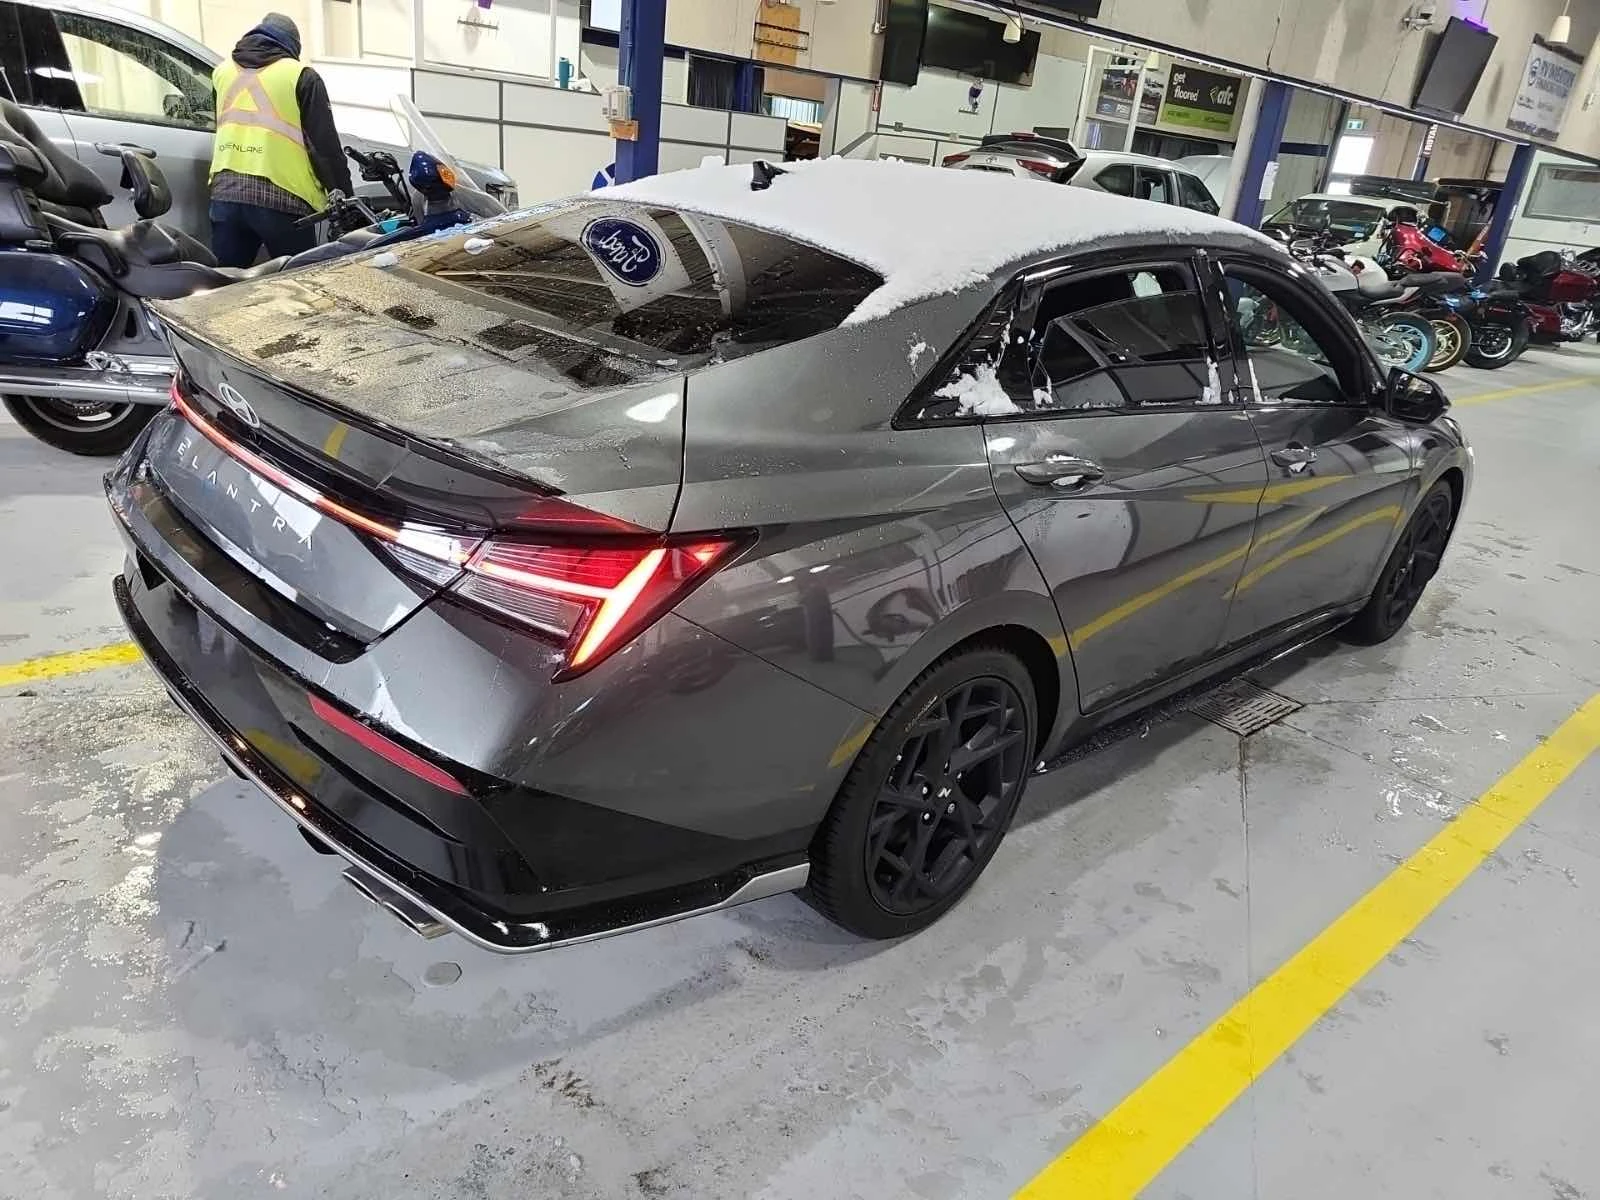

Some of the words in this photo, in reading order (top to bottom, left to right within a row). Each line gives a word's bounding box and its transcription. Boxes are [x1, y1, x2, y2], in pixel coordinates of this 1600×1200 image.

[1173, 71, 1187, 85] get
[1174, 86, 1200, 102] floored
[1218, 84, 1234, 106] afc
[177, 437, 313, 551] ELANTRA
